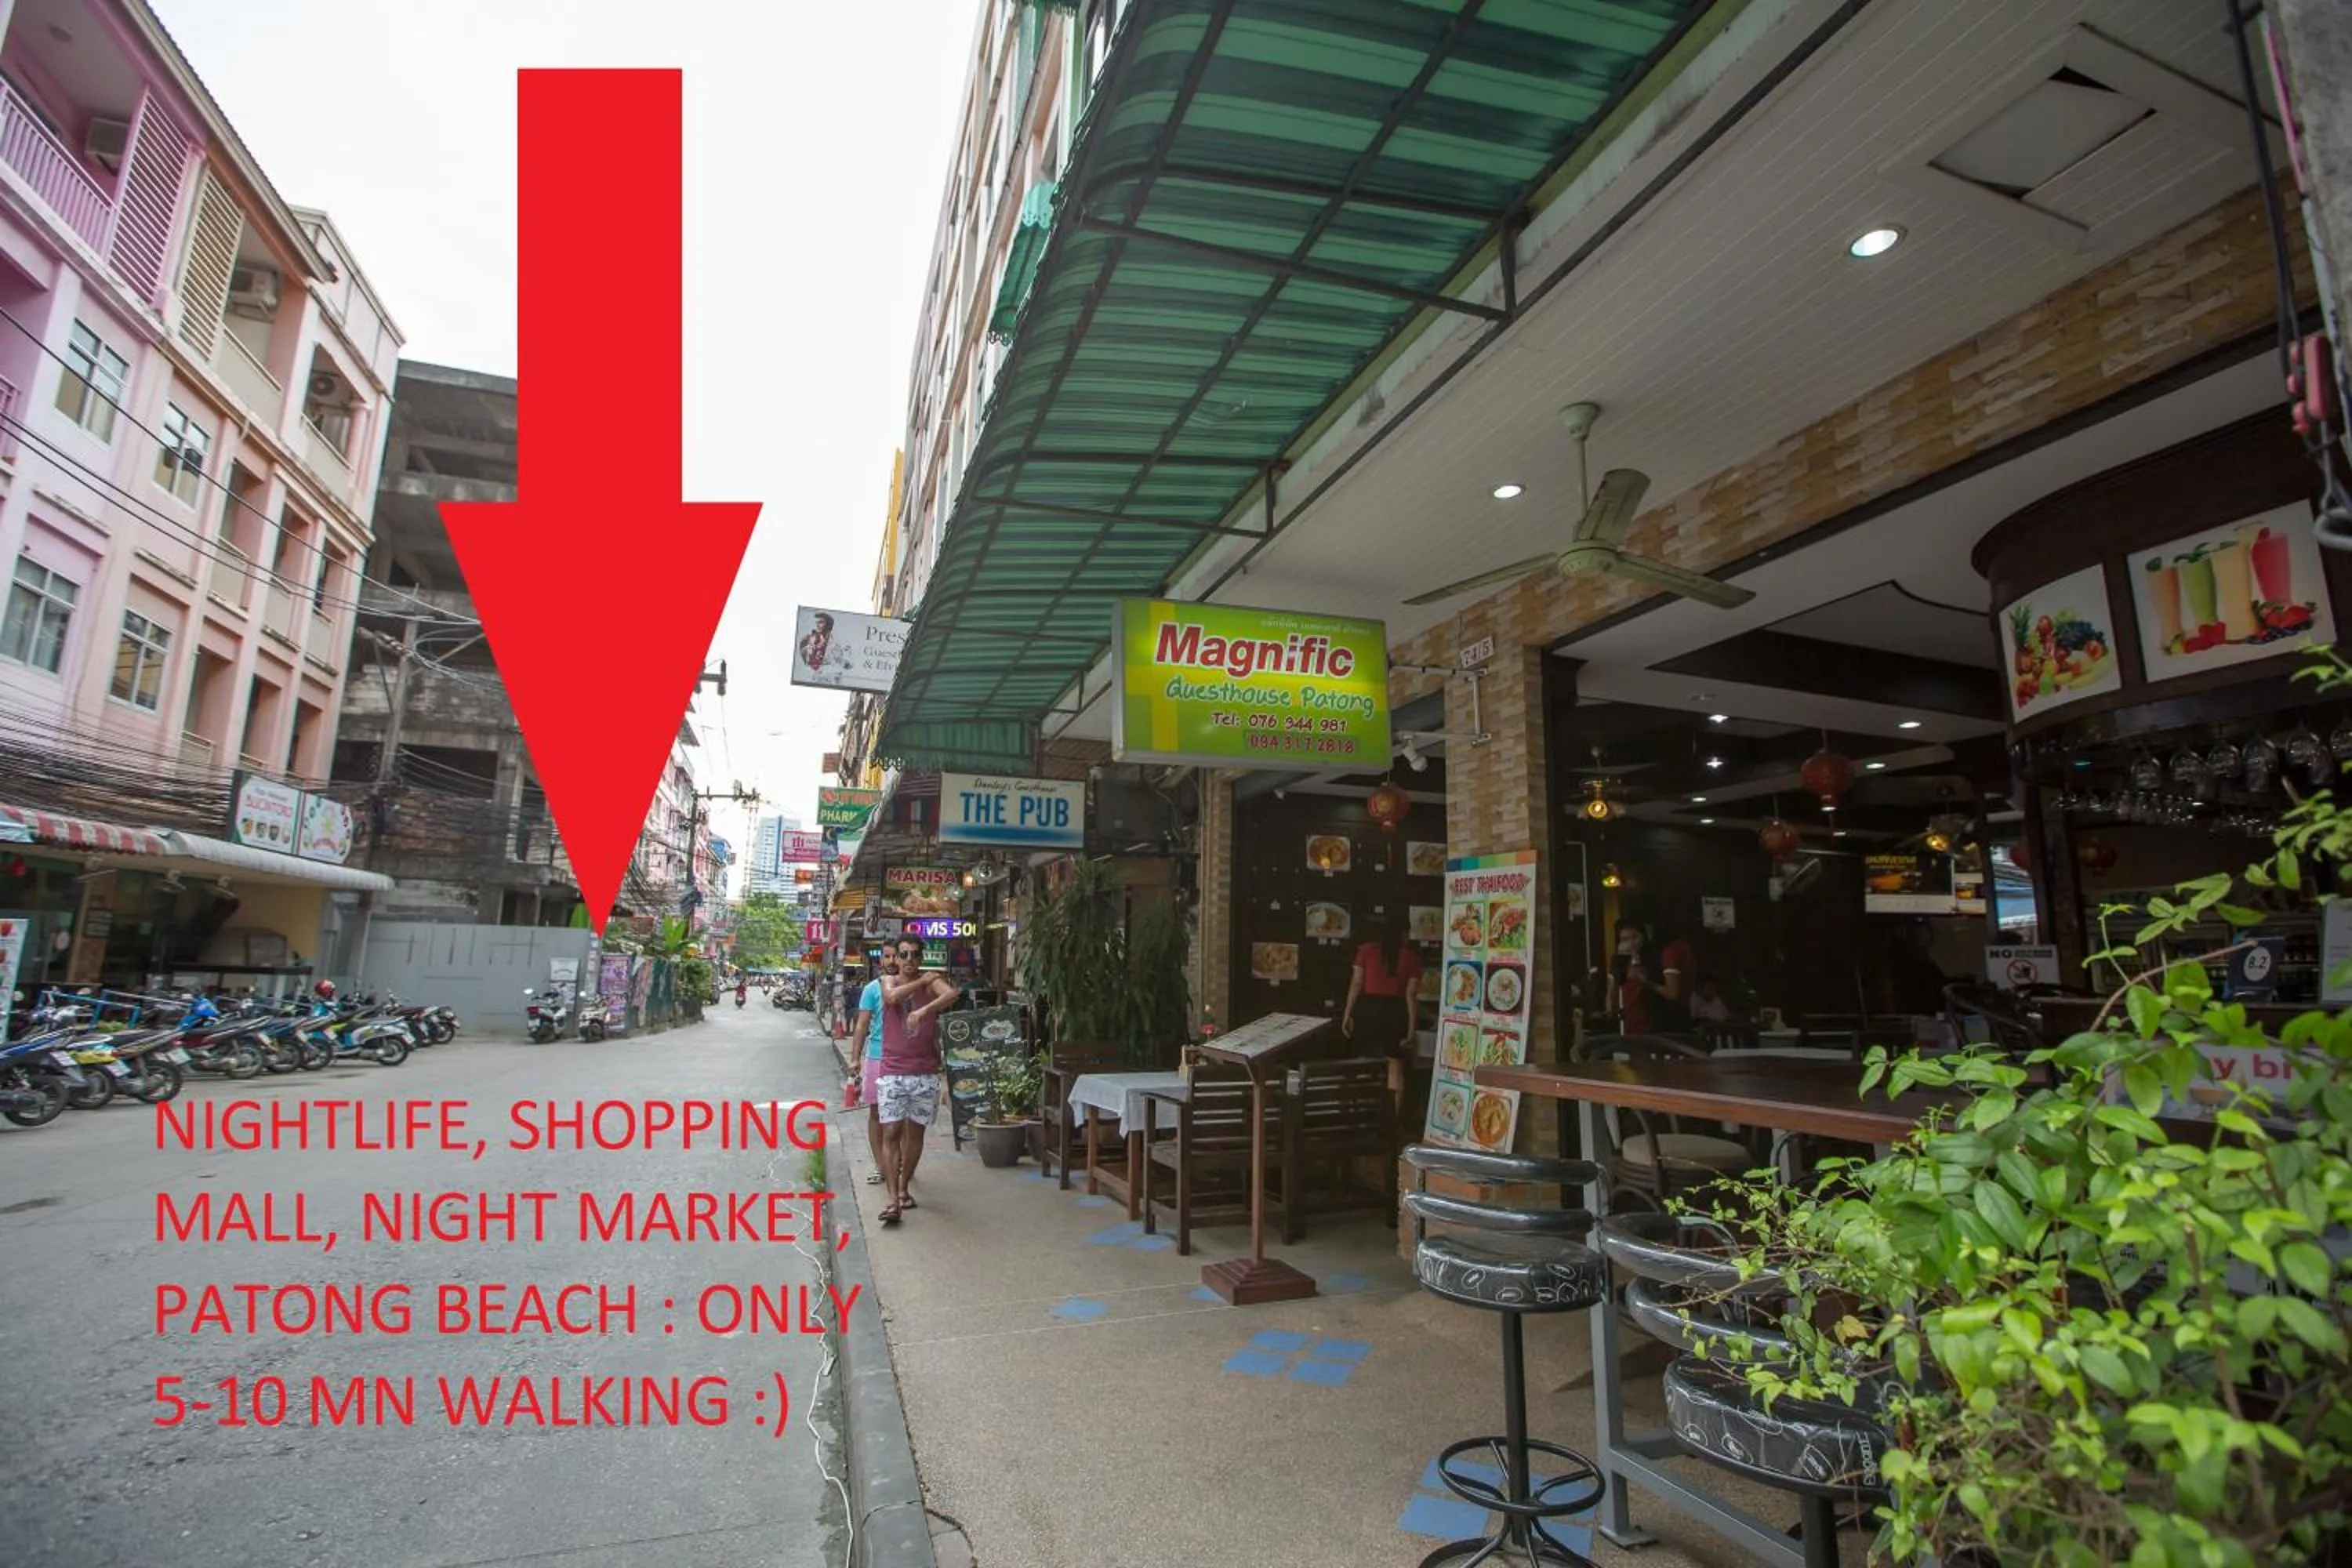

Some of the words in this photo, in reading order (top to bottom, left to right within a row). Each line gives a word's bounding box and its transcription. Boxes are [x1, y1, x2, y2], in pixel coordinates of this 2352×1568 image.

[1155, 622, 1355, 678] Magnific
[1166, 675, 1291, 706] Guesthouse
[1301, 686, 1375, 718] Patong
[1213, 712, 1240, 726] Tel:
[1249, 714, 1277, 728] 076
[960, 790, 1008, 824] THE
[1020, 796, 1069, 827] PUB
[888, 869, 955, 884] MARISA
[1454, 877, 1475, 895] BEST
